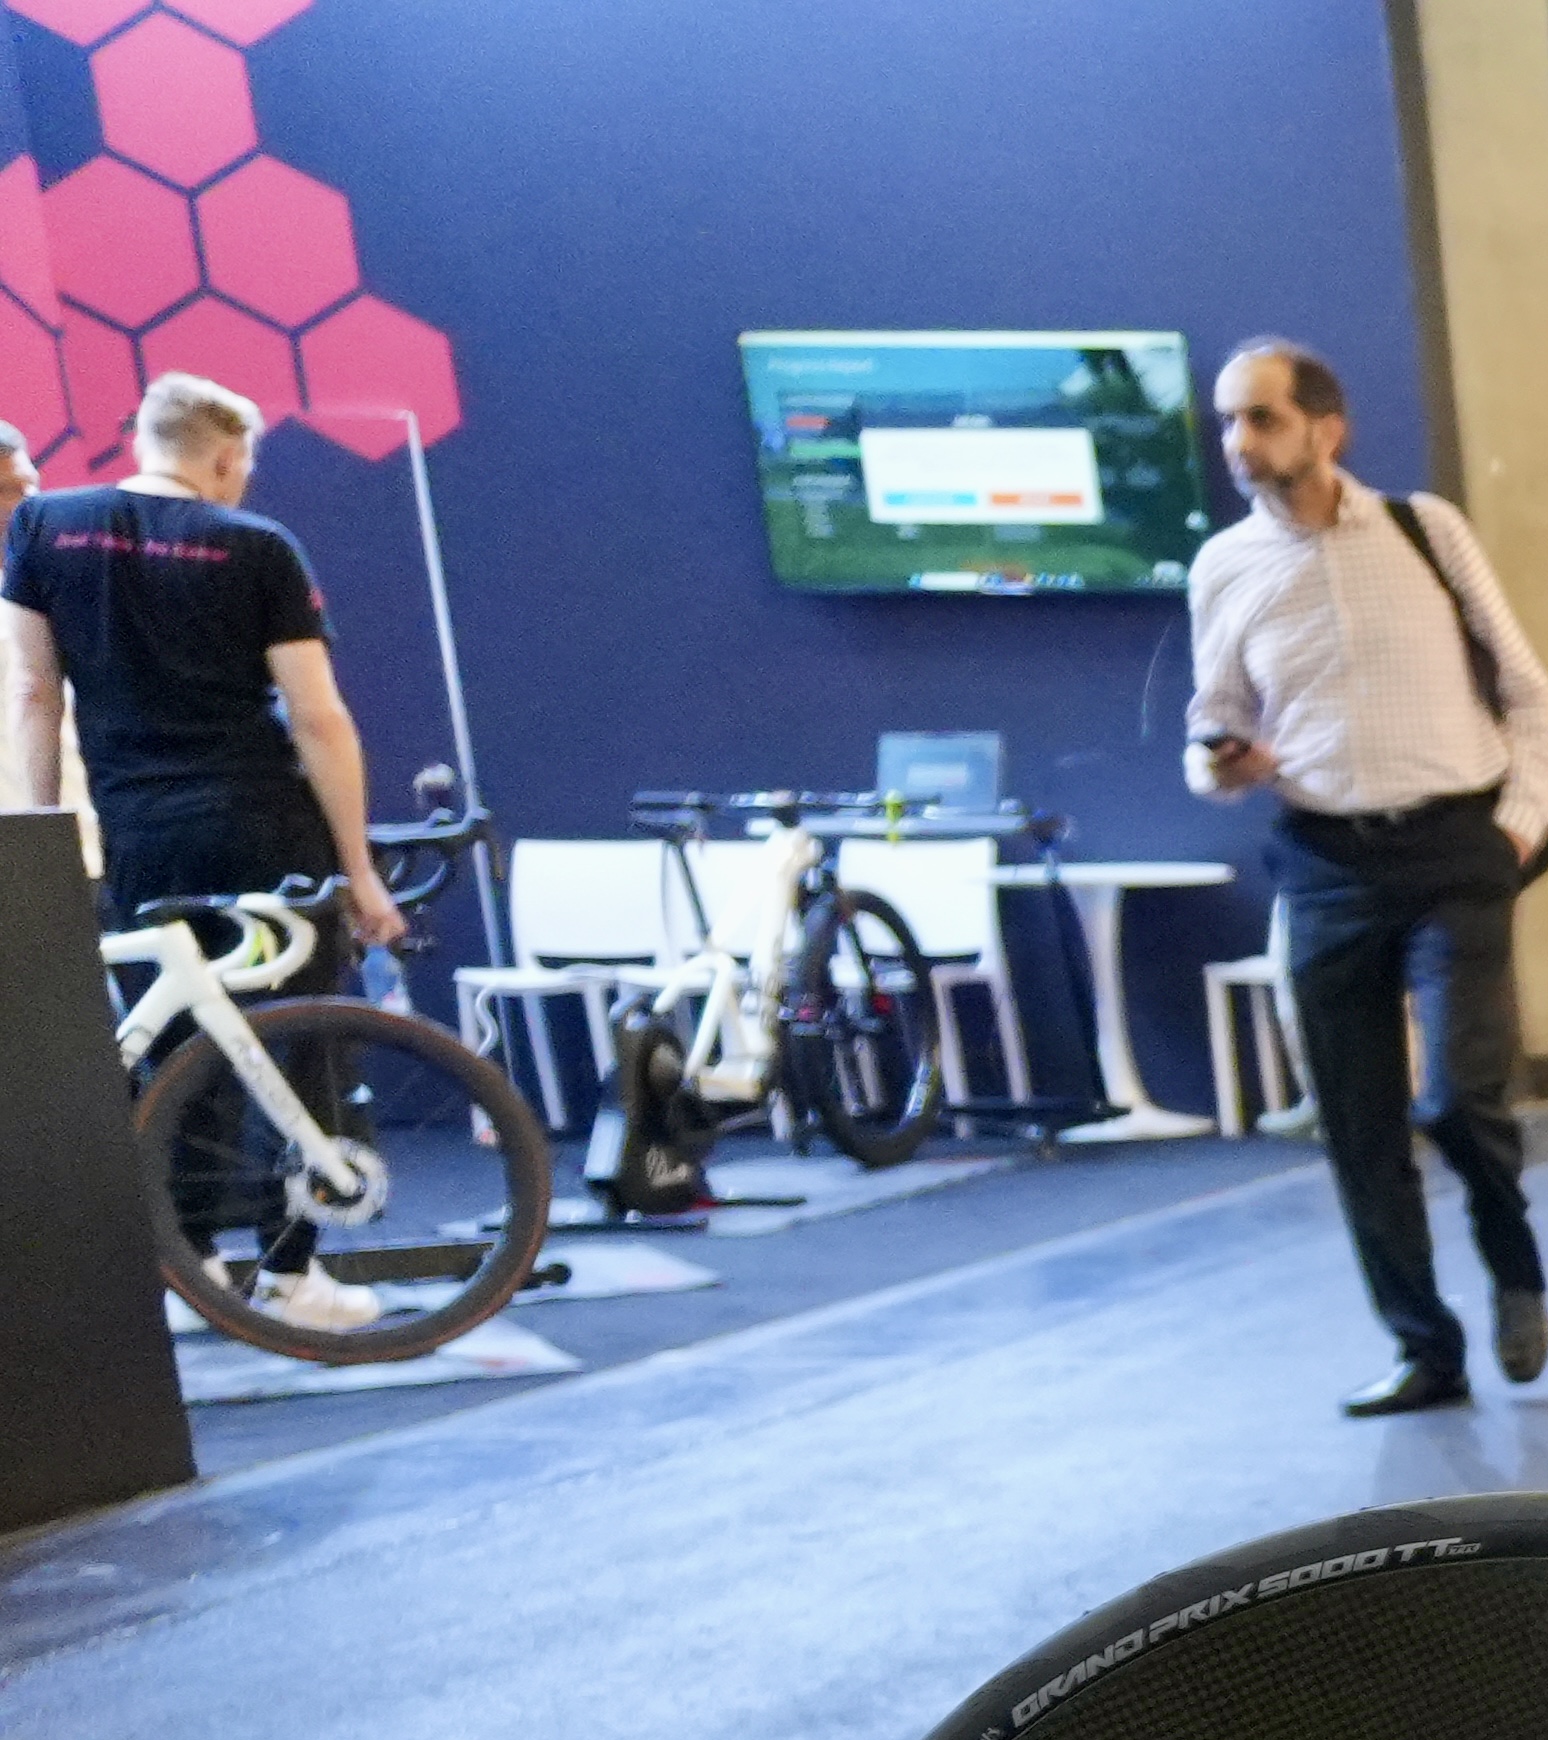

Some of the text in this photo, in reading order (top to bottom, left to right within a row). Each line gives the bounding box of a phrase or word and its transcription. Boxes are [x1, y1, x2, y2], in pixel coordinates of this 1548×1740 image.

[1012, 1629, 1144, 1729] GRAND
[1148, 1583, 1258, 1645] PRIX
[1256, 1546, 1398, 1599] 5000
[1394, 1537, 1464, 1564] TT
